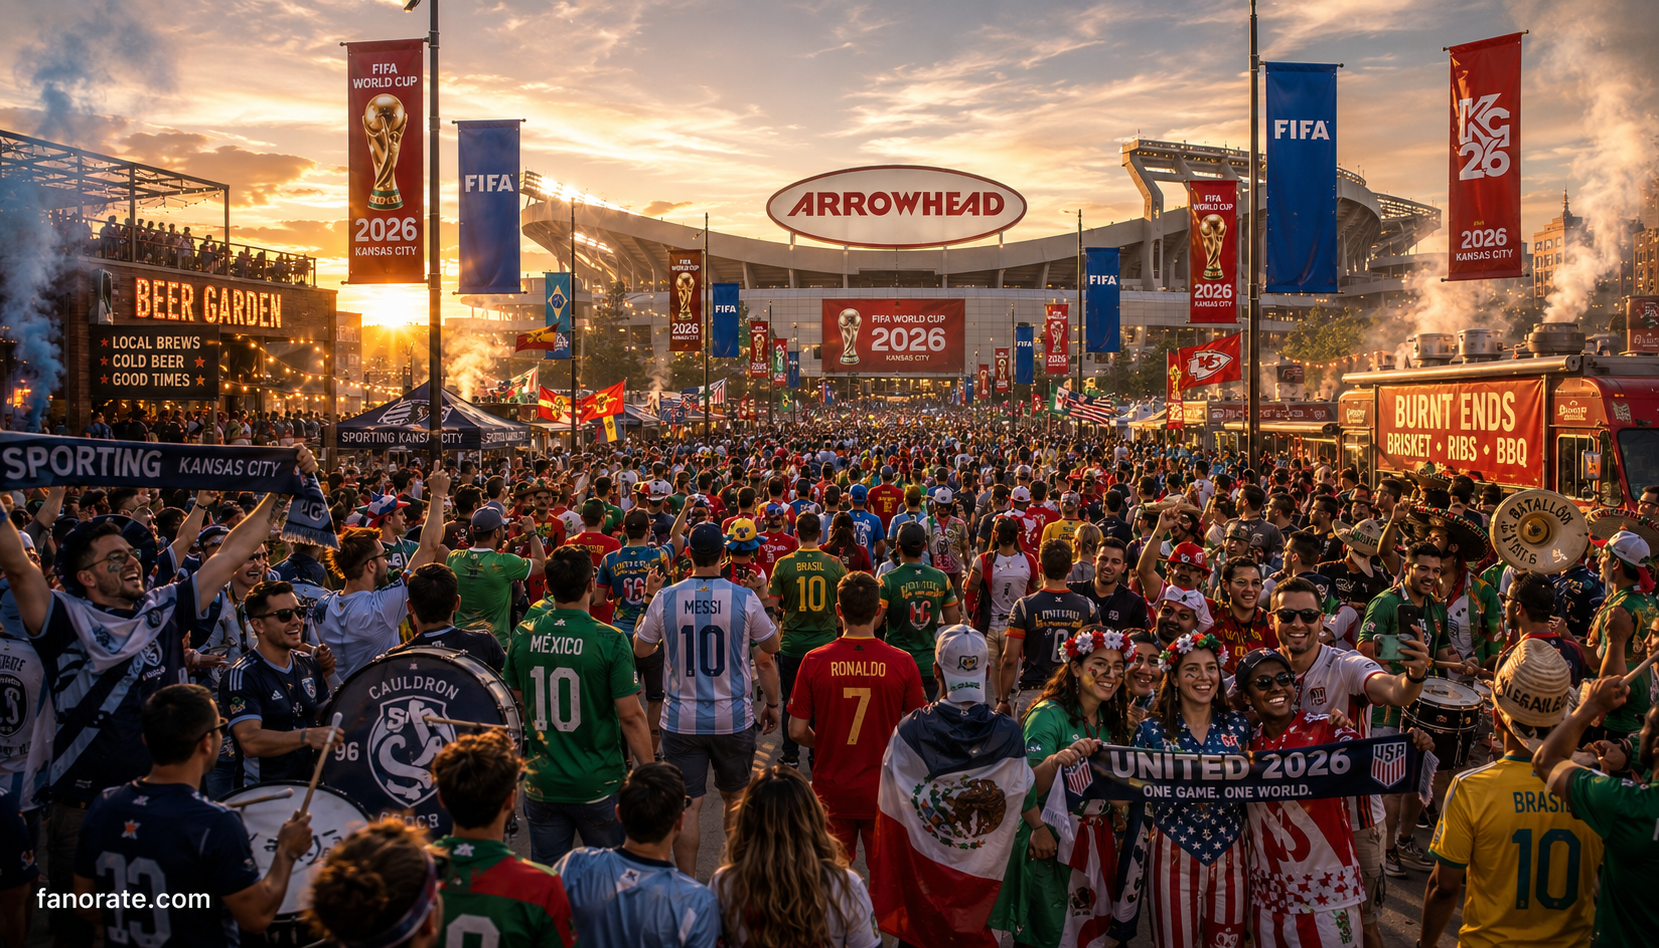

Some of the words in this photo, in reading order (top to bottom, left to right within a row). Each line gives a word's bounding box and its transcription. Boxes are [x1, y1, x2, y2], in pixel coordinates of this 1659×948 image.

[372, 63, 398, 74] FIFA
[353, 77, 392, 89] WORLD
[395, 75, 418, 87] CUP
[1274, 119, 1330, 140] FIFA
[465, 174, 514, 192] FIFA
[787, 191, 1005, 217] ARROWHEAD
[1205, 194, 1222, 202] FIFA
[355, 217, 418, 242] 2026
[1461, 228, 1508, 249] 2026
[355, 246, 393, 256] KANSAS
[395, 245, 417, 255] CITY
[1456, 250, 1490, 262] KANSAS
[1492, 249, 1513, 260] CITY
[1090, 275, 1117, 286] FIFA
[1194, 283, 1233, 299] 2026
[135, 277, 195, 322] BEER
[203, 284, 282, 328] GARDEN
[715, 305, 737, 313] FIFA
[872, 315, 891, 323] FIFA
[893, 315, 925, 323] WORLD
[927, 315, 946, 323] CUP
[672, 323, 699, 334] 2026
[112, 335, 152, 349] LOCAL
[156, 335, 201, 349] BREWS
[871, 328, 946, 352] 2026
[112, 353, 147, 368] COLD
[151, 353, 185, 368] BEER
[886, 354, 913, 362] KANSAS
[914, 354, 930, 362] CITY
[112, 372, 148, 386] GOOD
[152, 372, 190, 386] TIMES
[1395, 393, 1453, 430] BURNT
[1460, 391, 1516, 432] ENDS
[341, 431, 395, 444] SPORTING
[399, 432, 430, 443] KANSA
[441, 433, 463, 444] CITY
[1387, 432, 1432, 458] BRISKET
[1447, 435, 1478, 461] RIBS
[1496, 437, 1528, 468] BBQ
[2, 444, 163, 480] SPORTING
[179, 456, 244, 477] KANSAS
[247, 459, 282, 478] CITY
[796, 561, 825, 572] BRASIL
[796, 575, 827, 613] 10
[684, 600, 722, 615] MESSI
[530, 633, 584, 656] MÉXICO
[680, 624, 726, 678] 10
[830, 661, 887, 678] RONALDO
[369, 676, 460, 700] CAULDRON
[530, 665, 582, 733] 10
[843, 687, 871, 745] 7
[334, 741, 359, 761] 96
[1375, 743, 1405, 763] USA
[1109, 749, 1251, 780] UNITED
[1262, 747, 1351, 780] 2026
[1143, 784, 1172, 798] ONE
[1175, 786, 1220, 798] GAME.
[1224, 786, 1253, 798] ONE
[1257, 784, 1312, 798] WORLD.
[1511, 829, 1581, 911] 10
